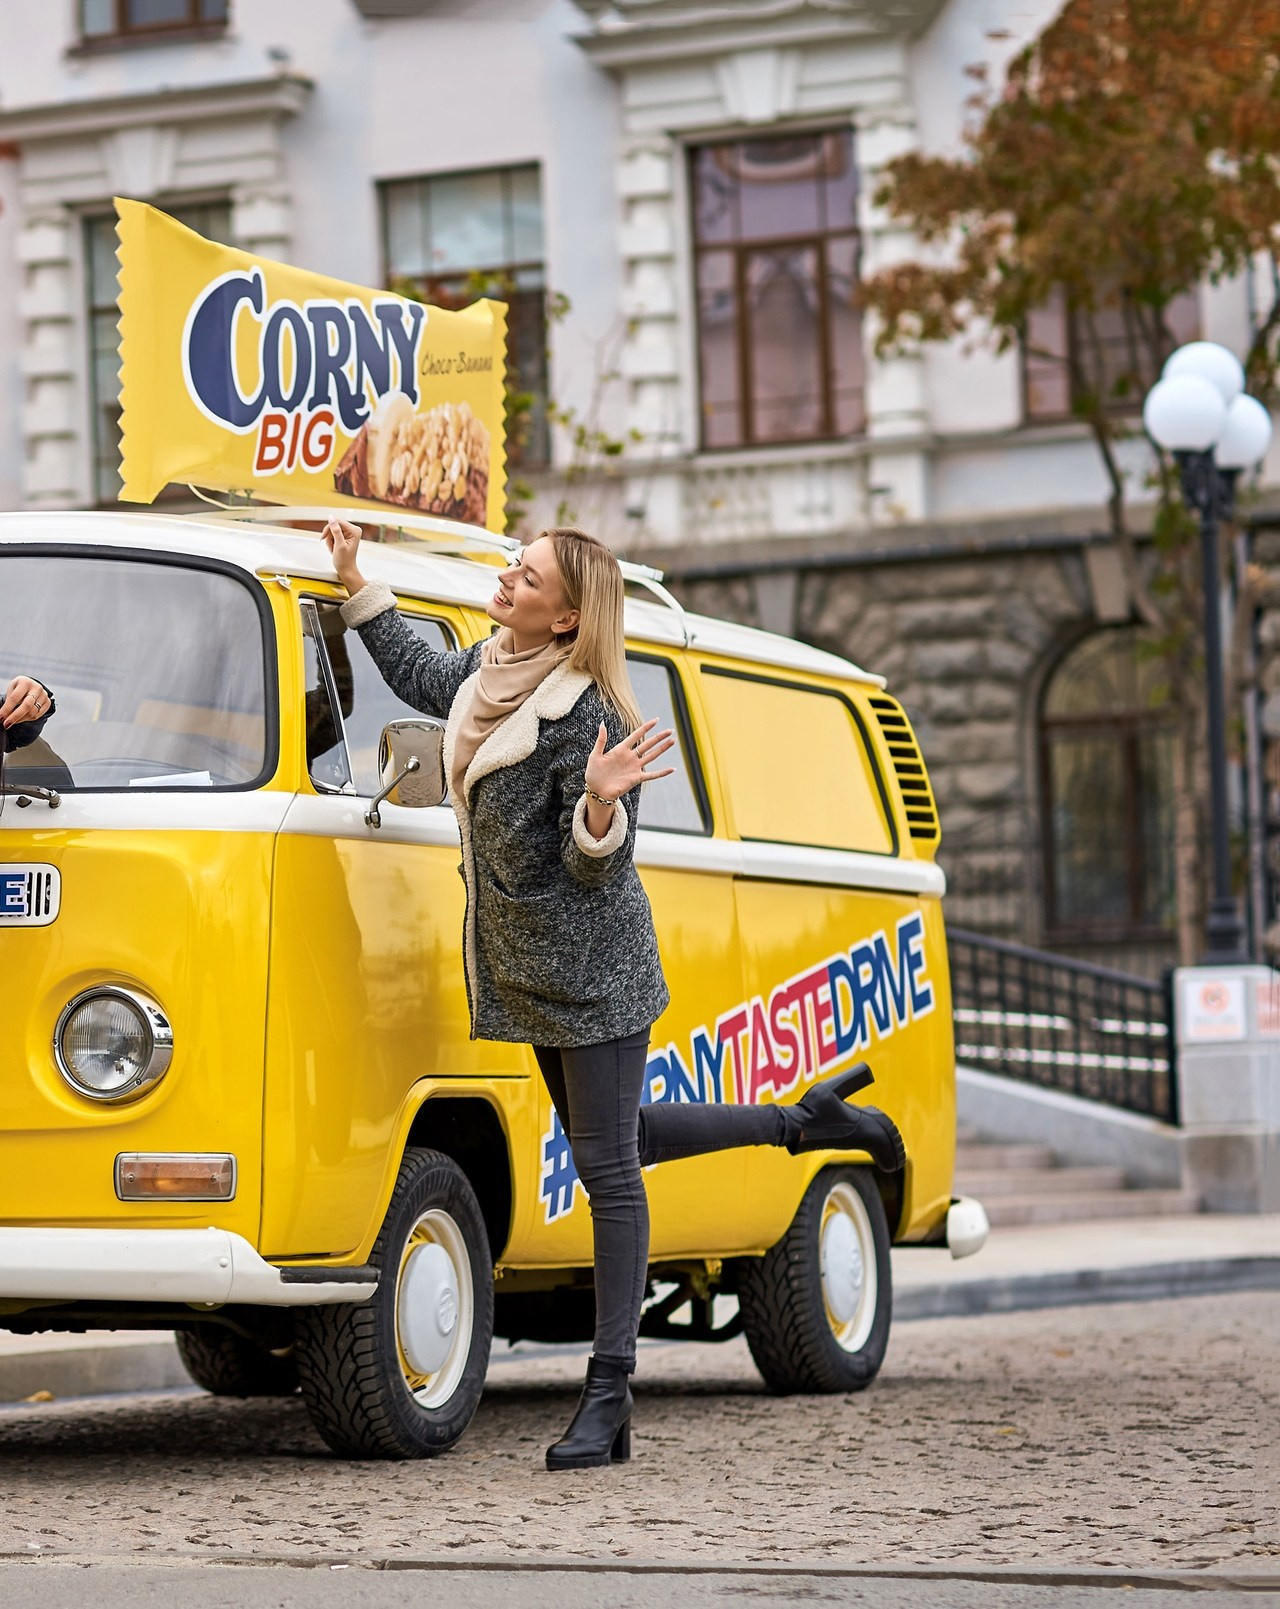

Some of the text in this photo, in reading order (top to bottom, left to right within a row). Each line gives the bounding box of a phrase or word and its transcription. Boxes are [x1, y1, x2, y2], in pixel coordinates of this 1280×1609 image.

[188, 272, 425, 430] CORNY
[255, 411, 335, 471] BIG
[541, 914, 933, 1220] #RNYTASTEDRIVE
